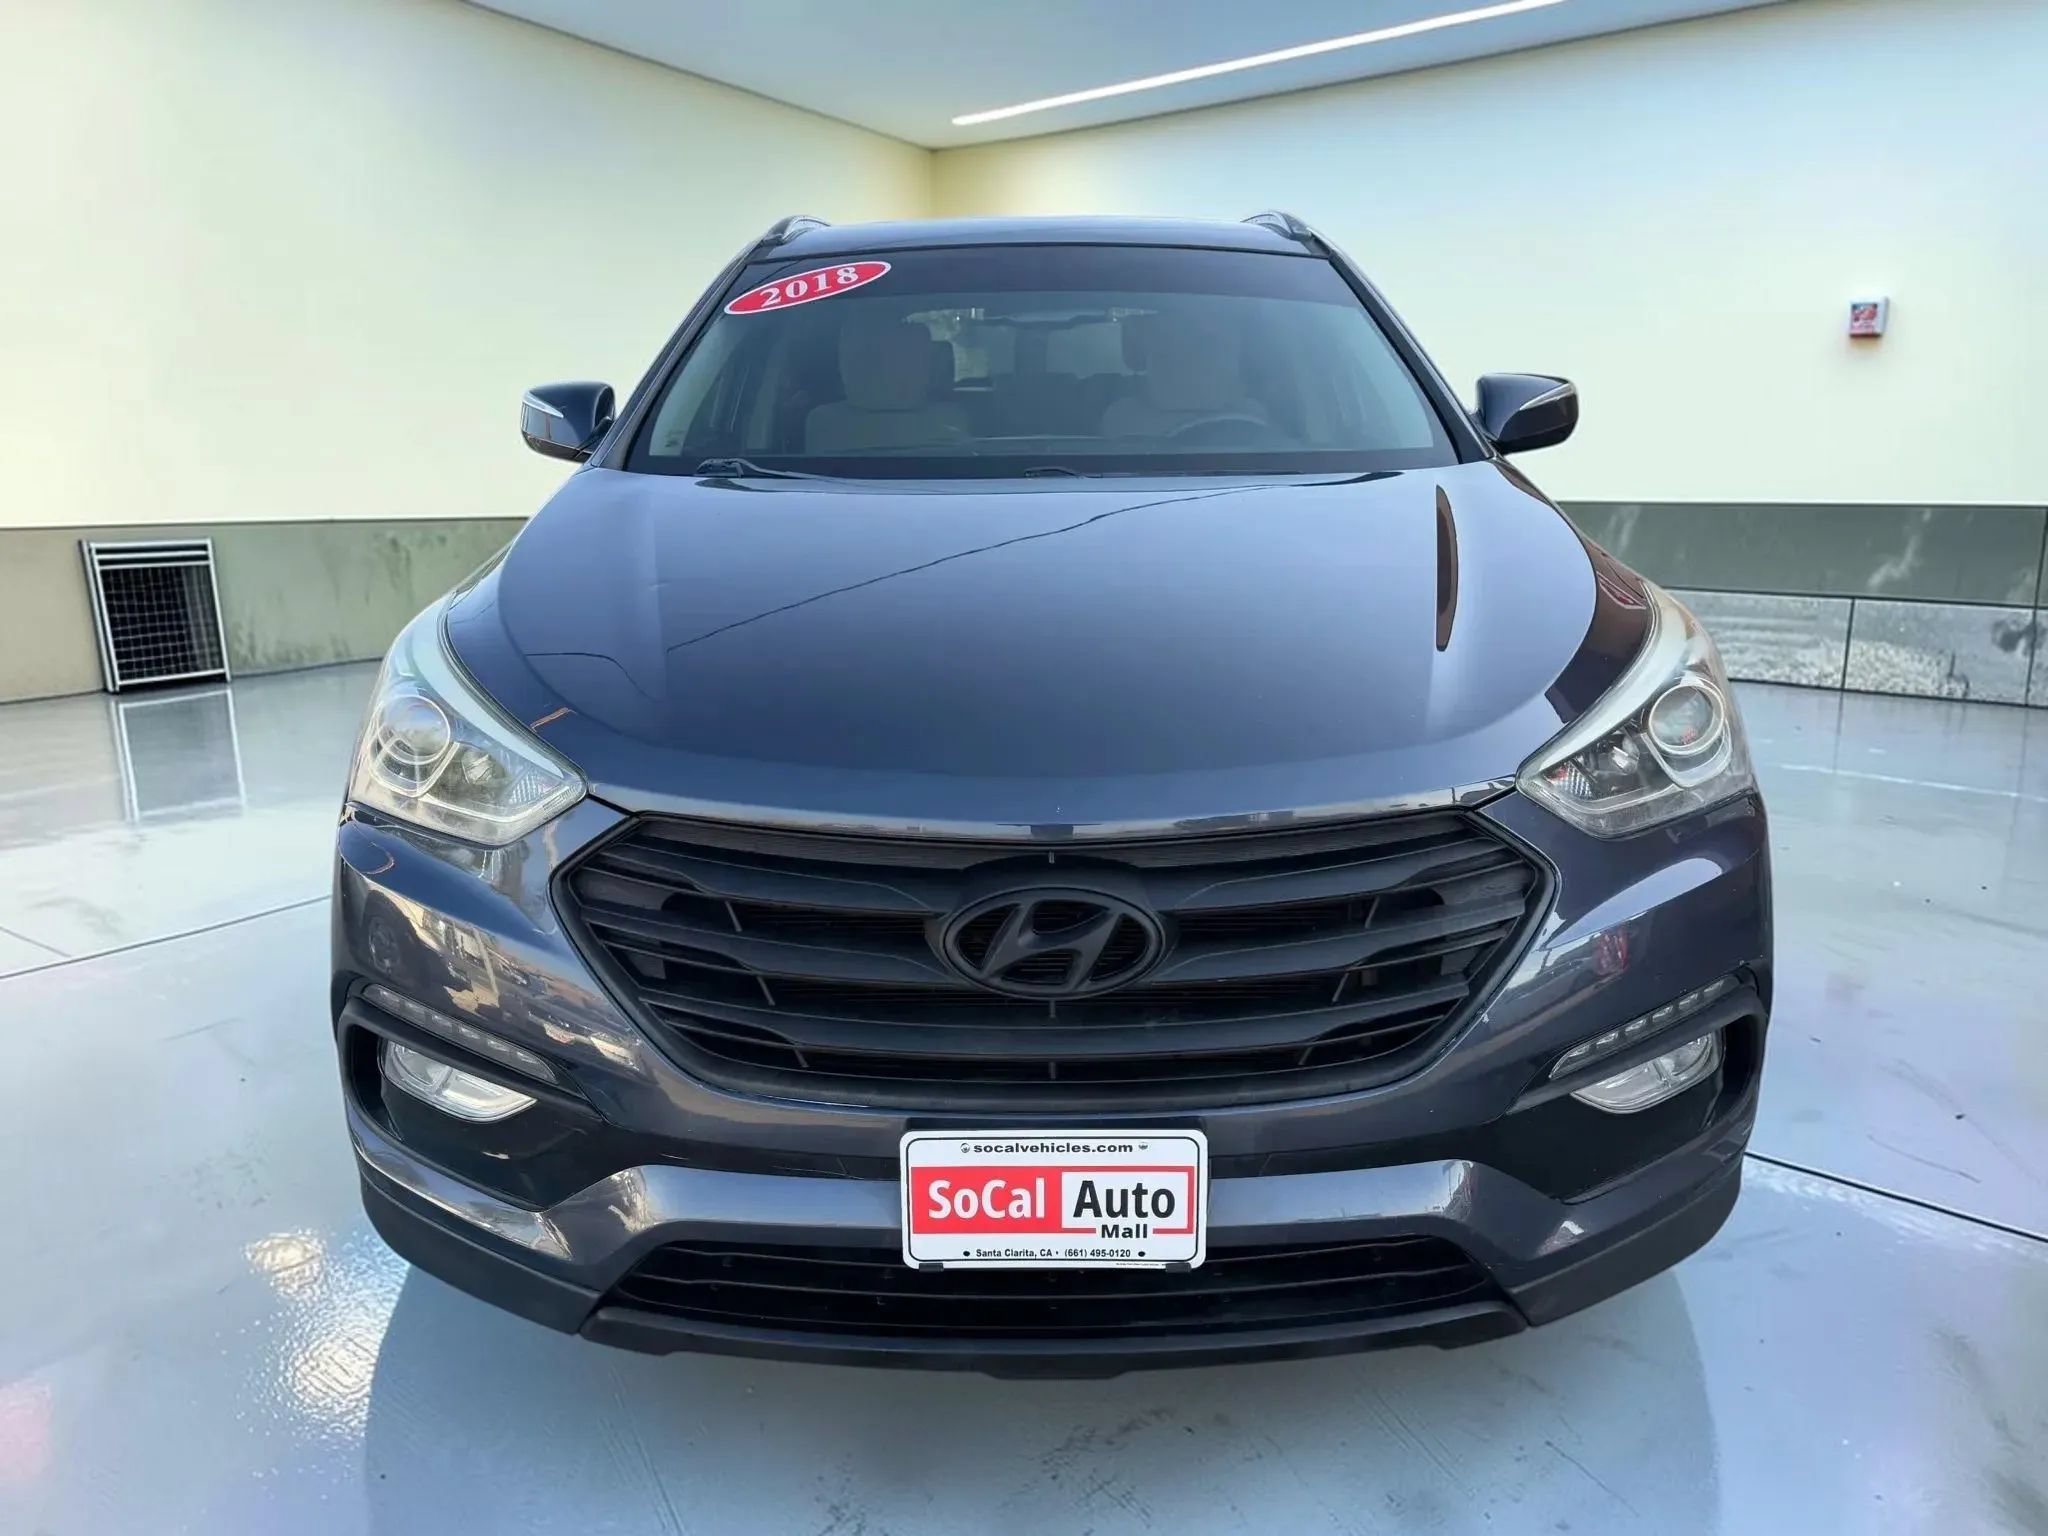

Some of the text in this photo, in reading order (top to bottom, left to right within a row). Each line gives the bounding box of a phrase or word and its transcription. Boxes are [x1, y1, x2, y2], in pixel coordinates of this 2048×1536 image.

[760, 267, 859, 307] 2018
[973, 1142, 1133, 1154] socalvehicles.com
[928, 1177, 1176, 1220] SoCal Auto
[1101, 1223, 1148, 1239] Mall
[975, 1248, 1131, 1259] Santa Clarita, CA (661) 495-0120
